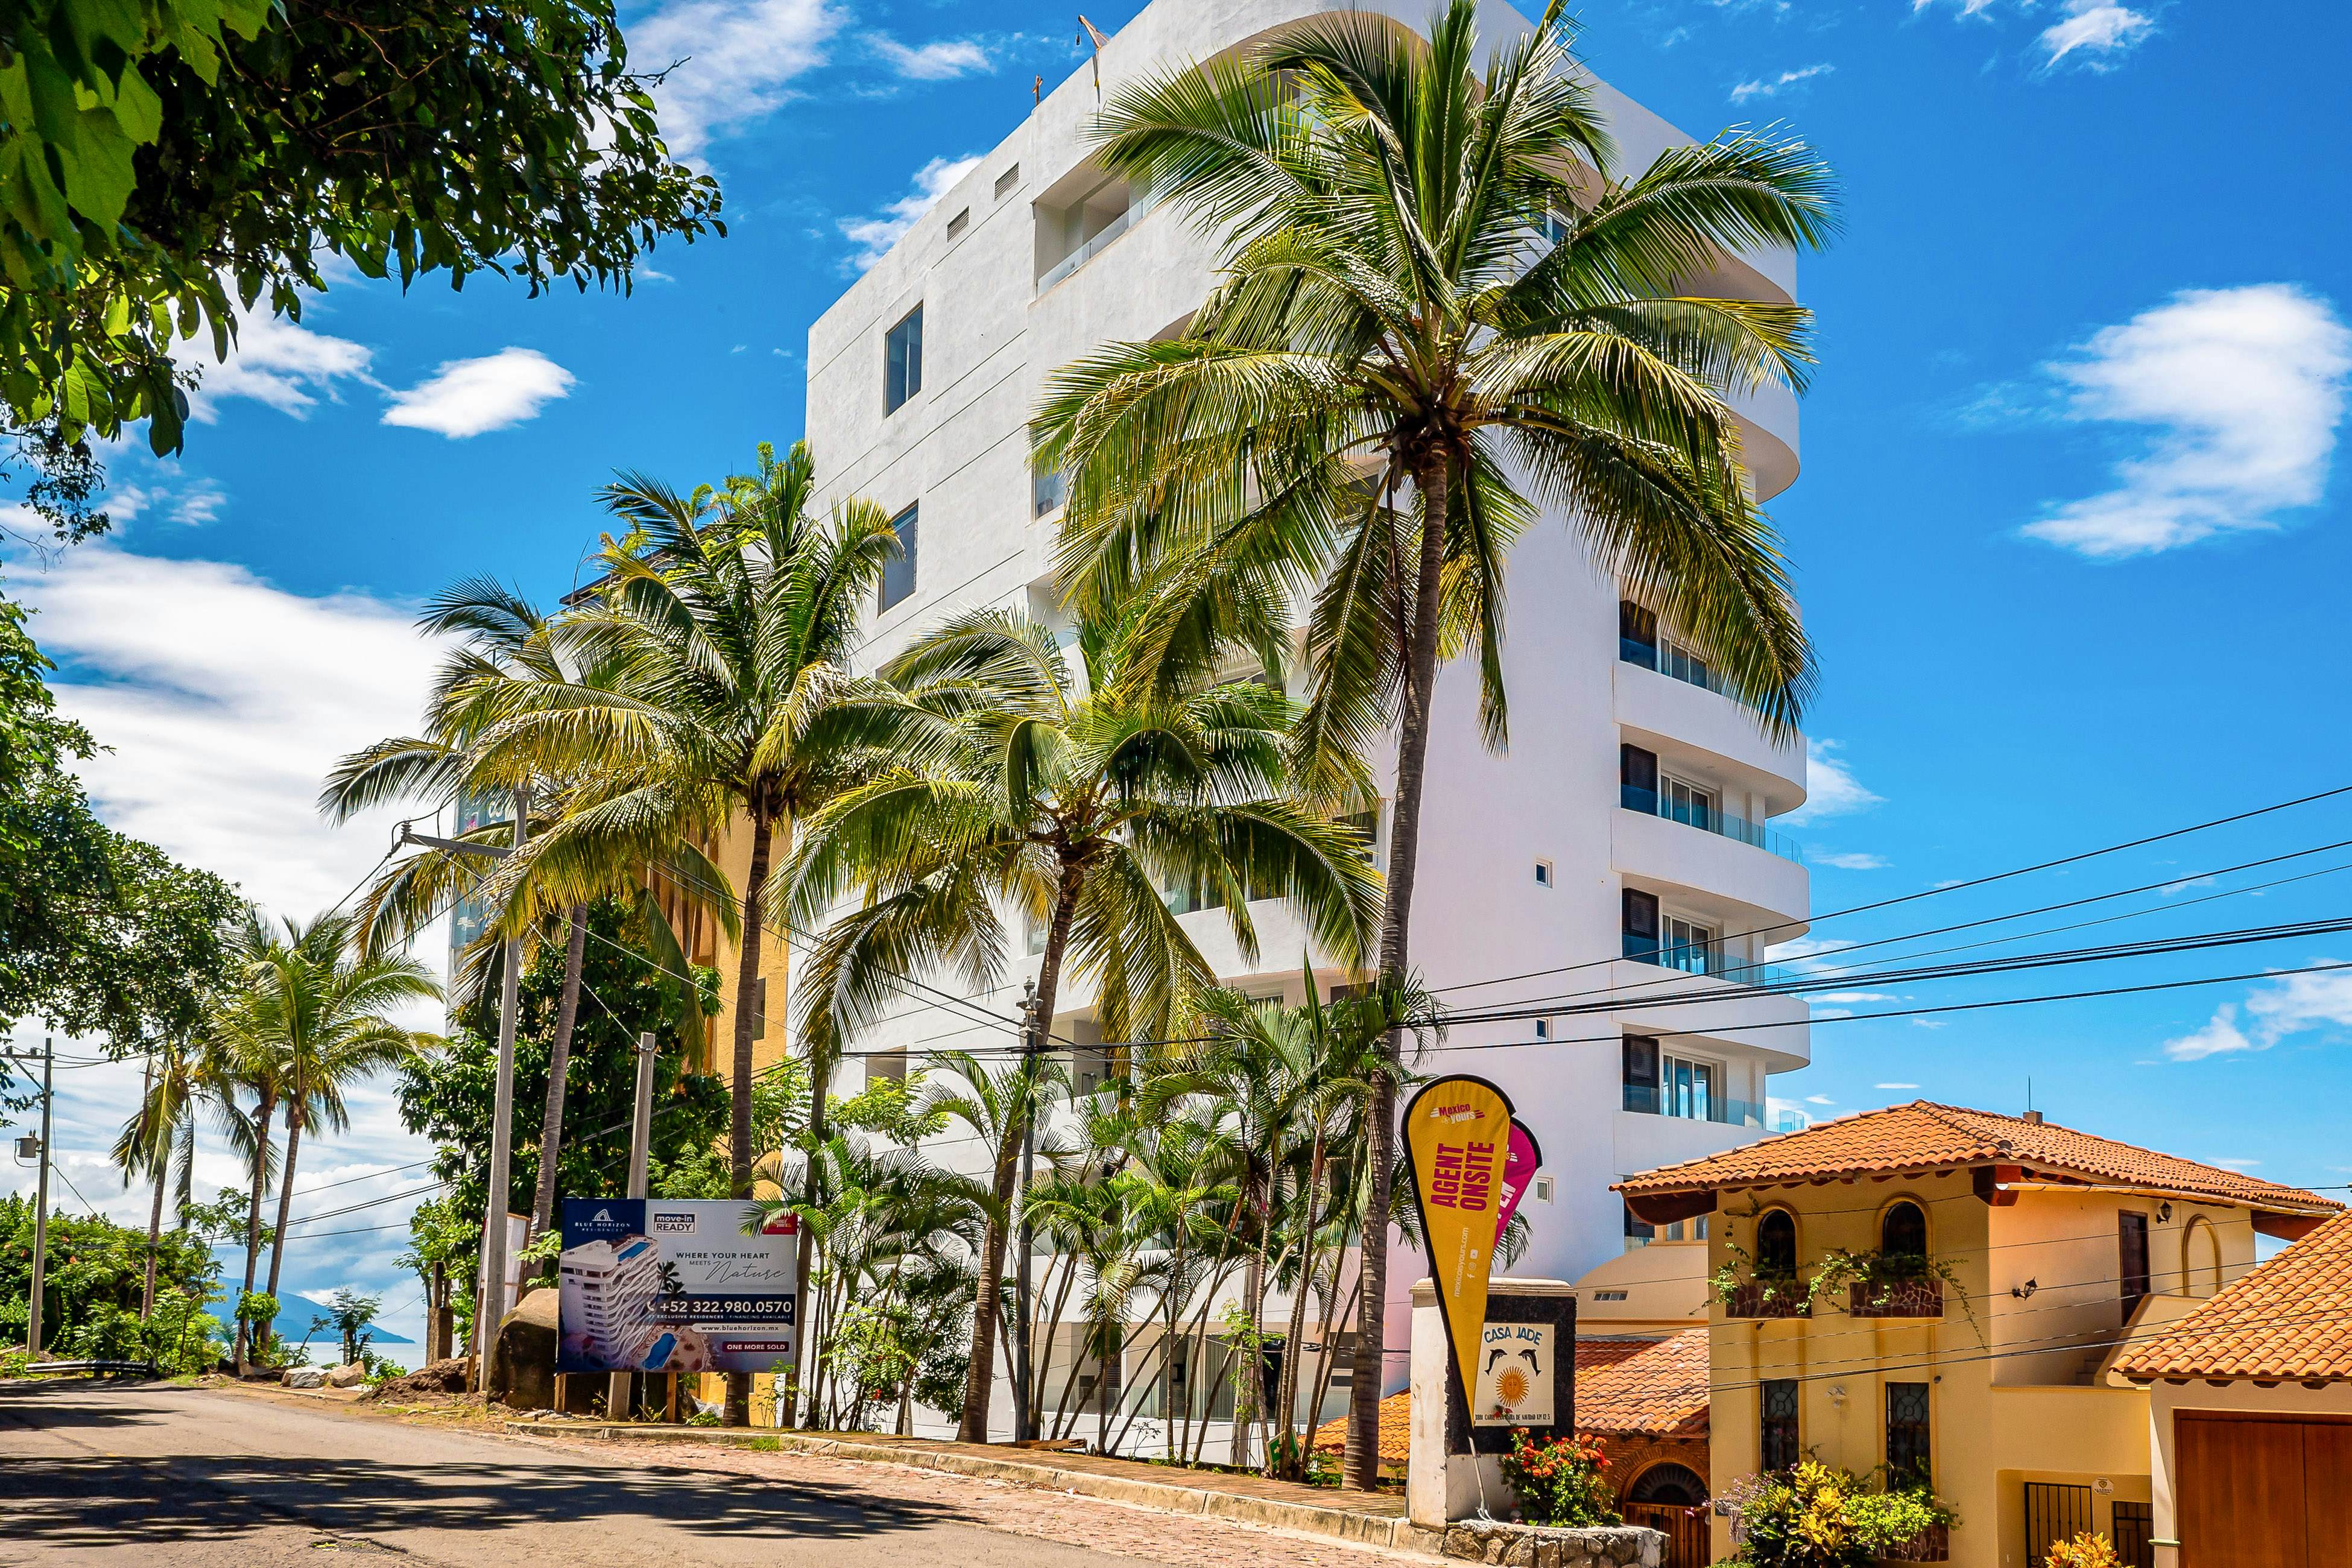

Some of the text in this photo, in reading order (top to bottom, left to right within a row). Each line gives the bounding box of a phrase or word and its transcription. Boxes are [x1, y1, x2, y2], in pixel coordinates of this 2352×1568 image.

[1438, 1104, 1470, 1118] Mexico
[1450, 1111, 1475, 1124] yours
[1430, 1143, 1464, 1209] AGENT
[1459, 1142, 1495, 1211] ONSITE
[705, 1260, 785, 1283] Nature
[1454, 1227, 1468, 1297] mexicoisyours.com
[660, 1301, 792, 1313] +52 322.980.0570
[1484, 1326, 1543, 1346] CASA JADE
